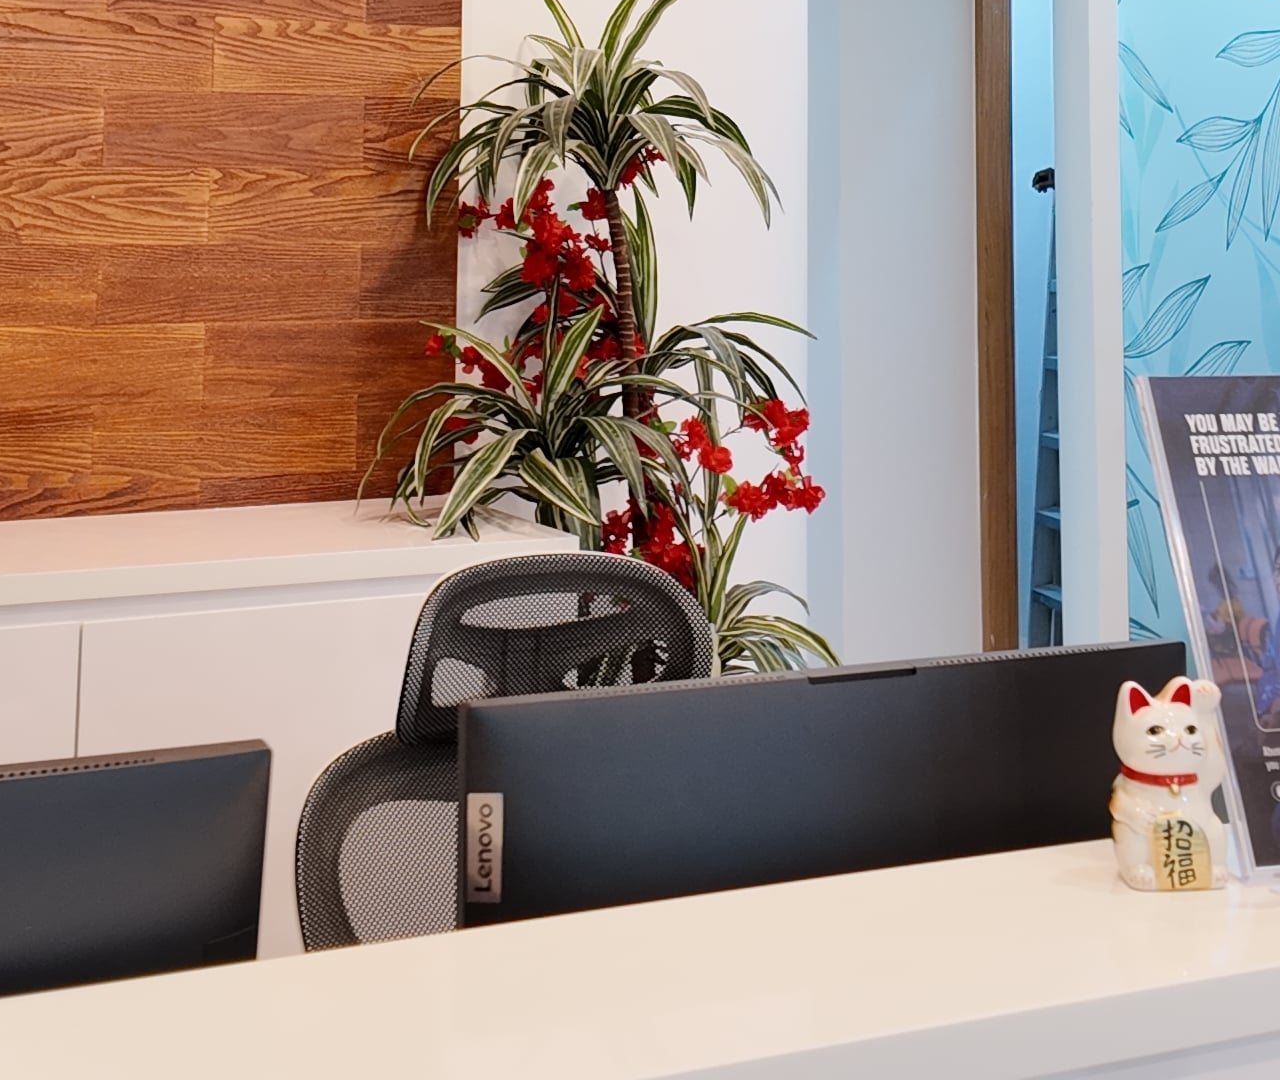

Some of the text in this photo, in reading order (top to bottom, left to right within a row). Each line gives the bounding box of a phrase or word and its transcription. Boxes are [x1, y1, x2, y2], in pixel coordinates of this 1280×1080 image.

[1183, 412, 1280, 433] YOU MAY BE
[1194, 456, 1217, 476] BY
[1218, 455, 1252, 476] THE
[474, 803, 493, 893] Lenovo
